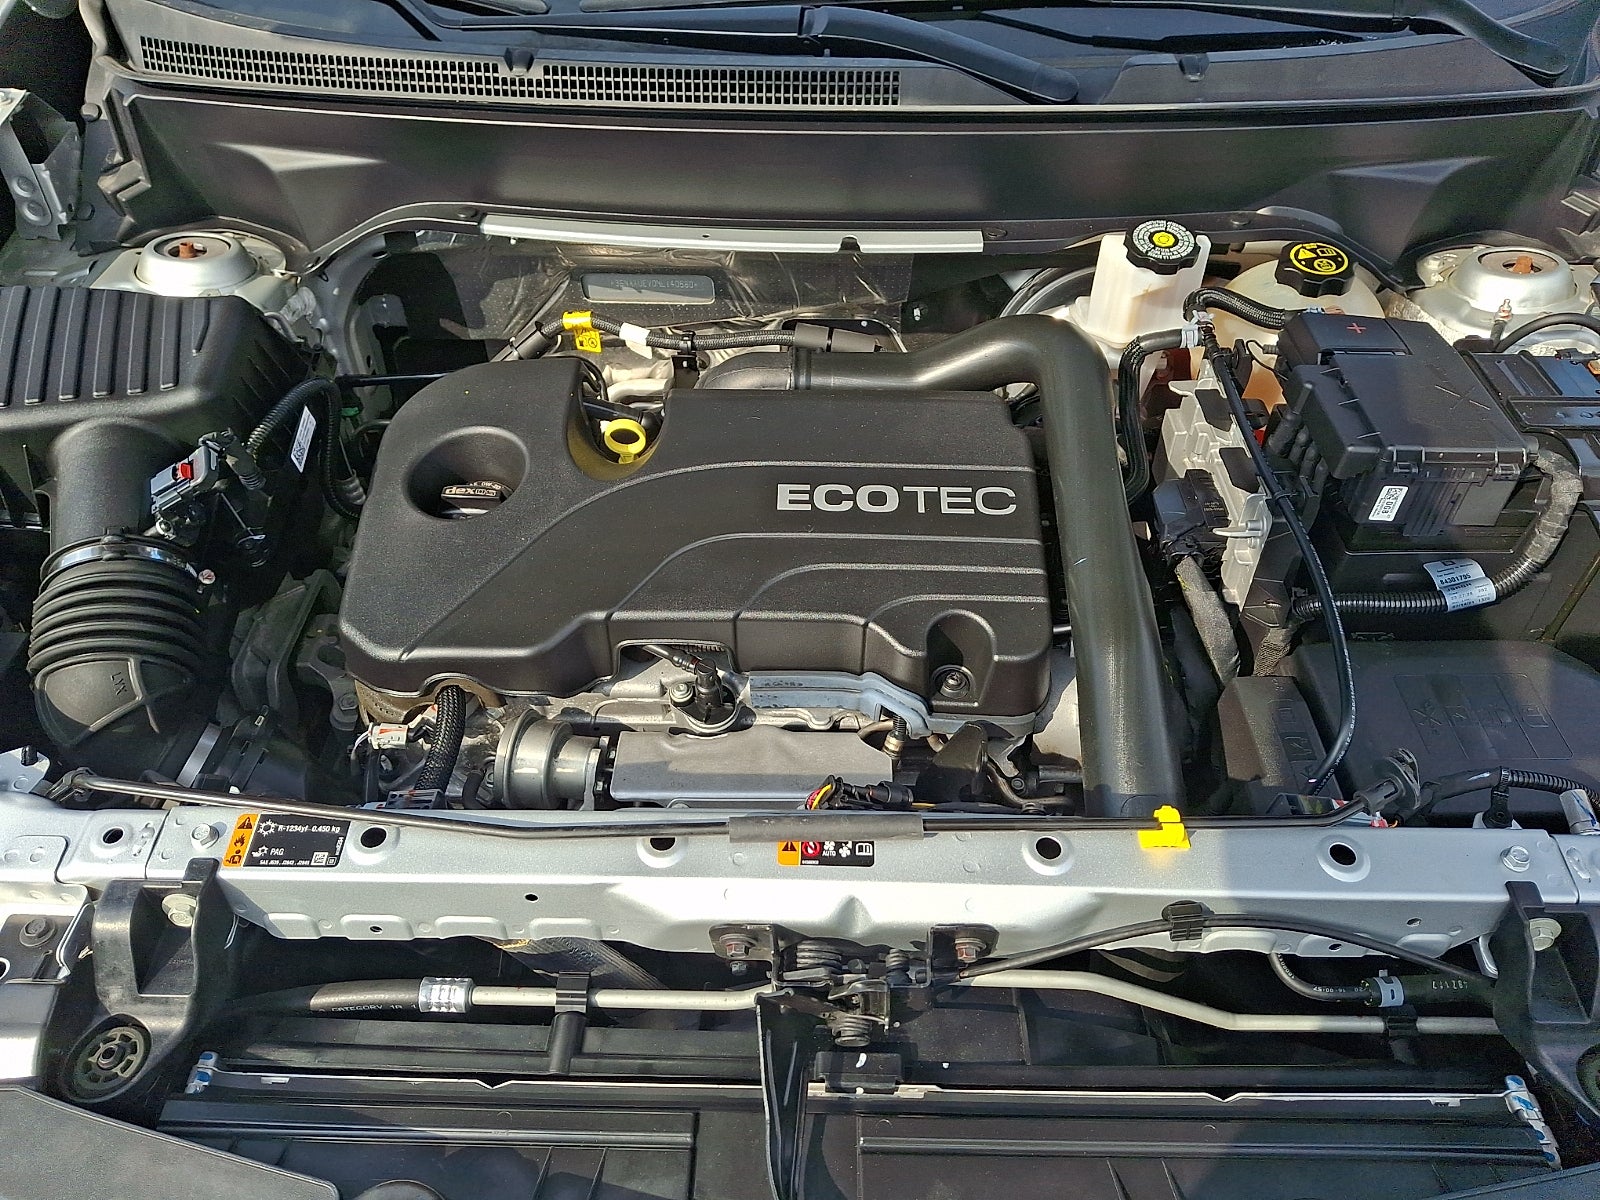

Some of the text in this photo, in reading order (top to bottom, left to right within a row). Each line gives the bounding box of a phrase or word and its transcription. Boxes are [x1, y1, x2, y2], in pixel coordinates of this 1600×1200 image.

[776, 483, 1017, 516] ECOTEC
[269, 848, 285, 856] PAG
[331, 1004, 383, 1013] CATEGORY
